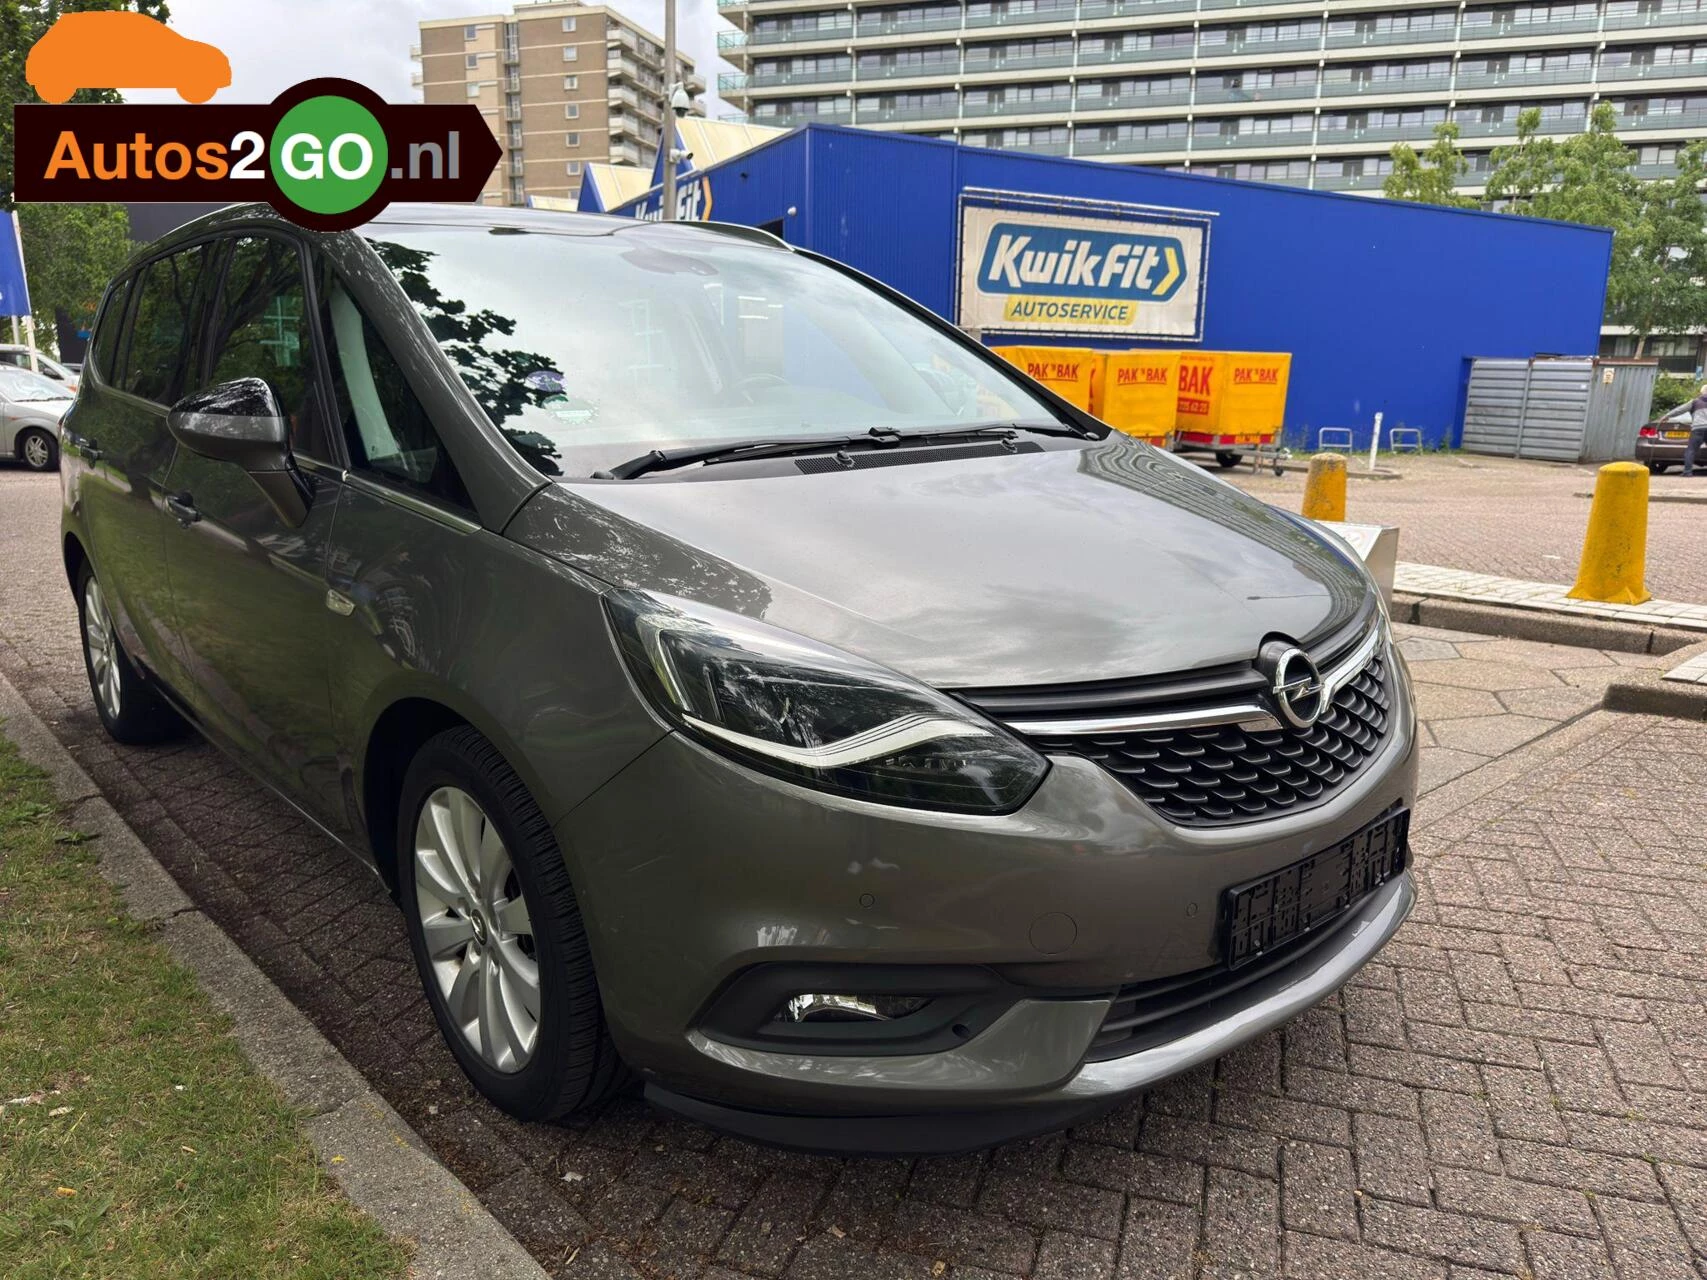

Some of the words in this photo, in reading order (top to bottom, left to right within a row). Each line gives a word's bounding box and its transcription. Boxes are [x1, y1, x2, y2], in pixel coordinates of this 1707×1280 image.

[1011, 301, 1129, 320] AUTOSERVICE
[1028, 362, 1049, 377] PAK
[1057, 363, 1079, 378] BAK
[1118, 367, 1138, 382] PAK
[1147, 367, 1168, 381] BAK
[1178, 365, 1214, 396] BAK
